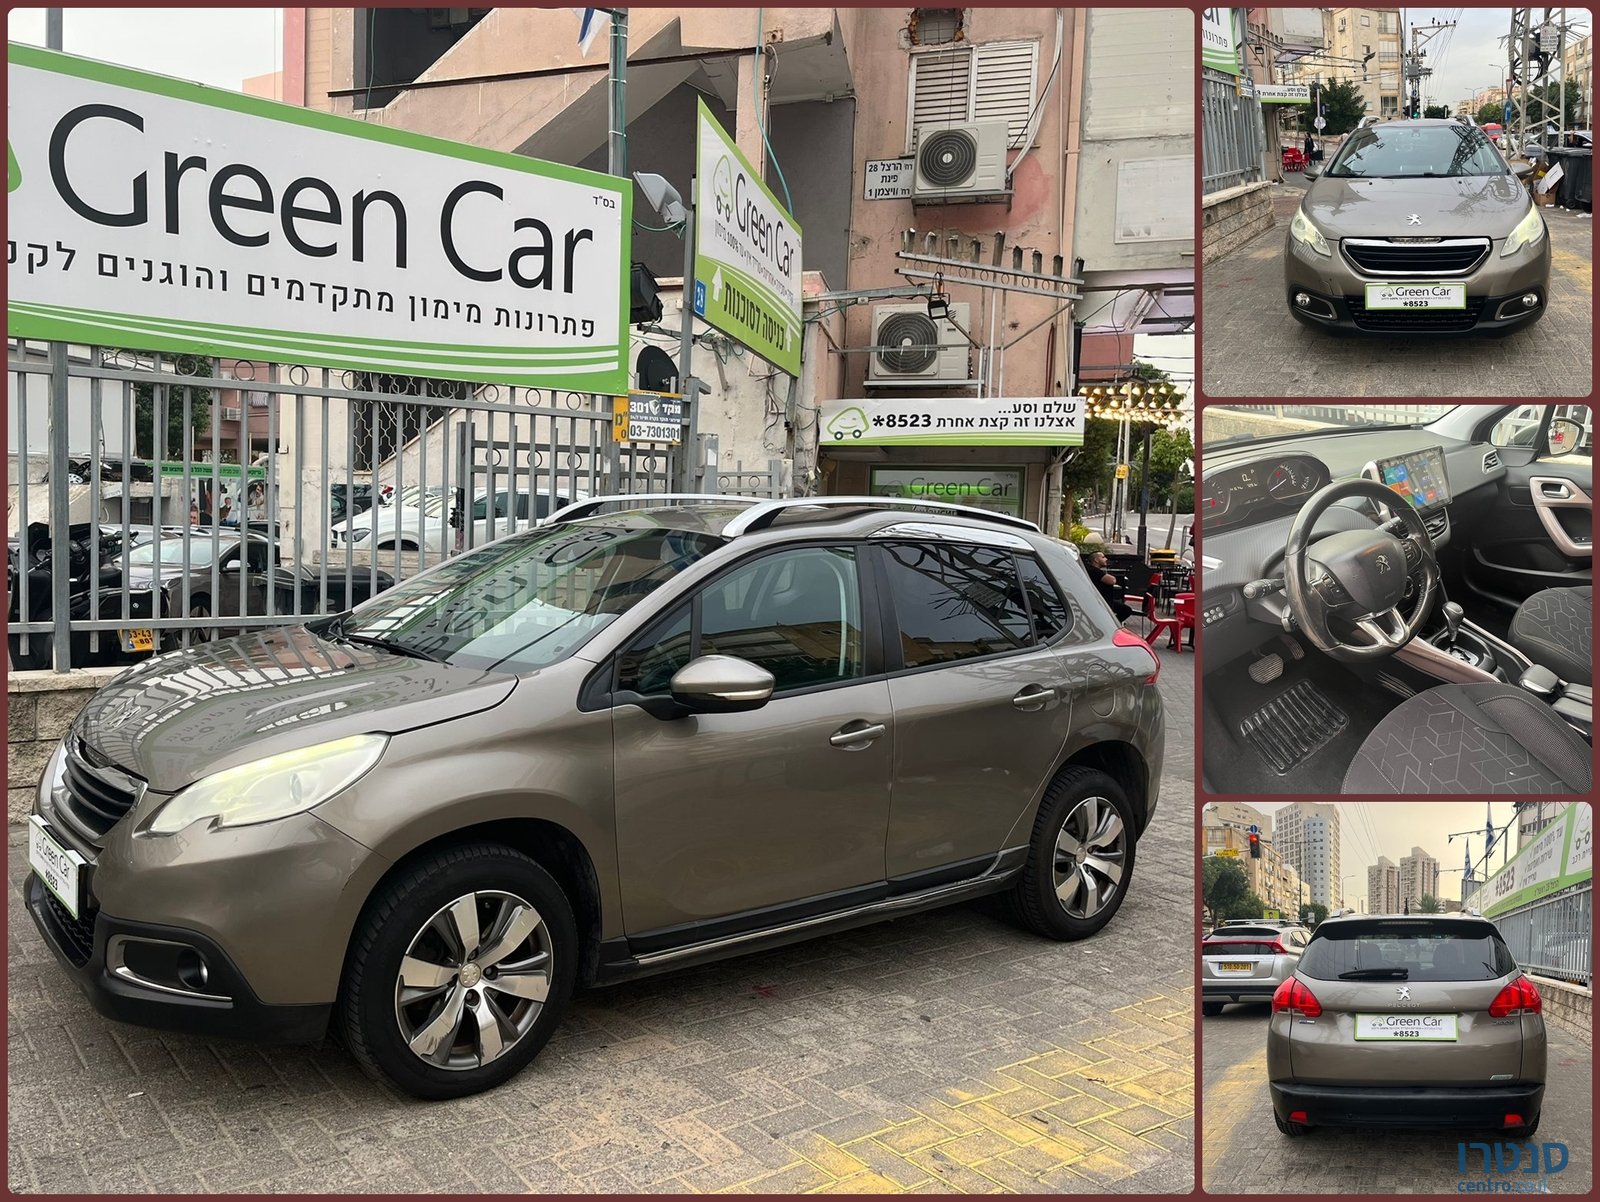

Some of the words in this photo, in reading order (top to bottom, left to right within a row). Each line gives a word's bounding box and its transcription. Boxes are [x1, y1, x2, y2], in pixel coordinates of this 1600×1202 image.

[868, 164, 878, 172] 28
[880, 162, 902, 171] הרצל
[880, 174, 898, 183] פינת
[48, 103, 407, 269] Green
[440, 180, 593, 294] Car
[592, 195, 616, 209] בס"ד
[735, 173, 773, 262] Green
[776, 220, 794, 281] Car
[98, 252, 228, 292] והוגנים
[247, 273, 394, 312] מתקדמים
[1396, 286, 1429, 296] Green
[1432, 286, 1451, 296] Car
[408, 295, 482, 323] מימון
[724, 281, 761, 334] לסוכנות
[494, 307, 595, 338] פתרונות
[762, 312, 784, 351] כניסה
[630, 402, 649, 413] 301
[998, 403, 1038, 414] וסע...
[1043, 401, 1076, 413] שלם
[936, 417, 974, 428] אחרת
[979, 417, 1009, 430] קצת
[1014, 417, 1030, 427] זה
[1034, 415, 1075, 427] אצלנו
[630, 424, 680, 439] 03-7301301
[910, 477, 970, 496] Green
[977, 478, 1012, 497] Car
[42, 836, 60, 868] Green
[60, 853, 70, 877] Car
[1386, 1016, 1420, 1026] Green
[1423, 1016, 1442, 1026] Car
